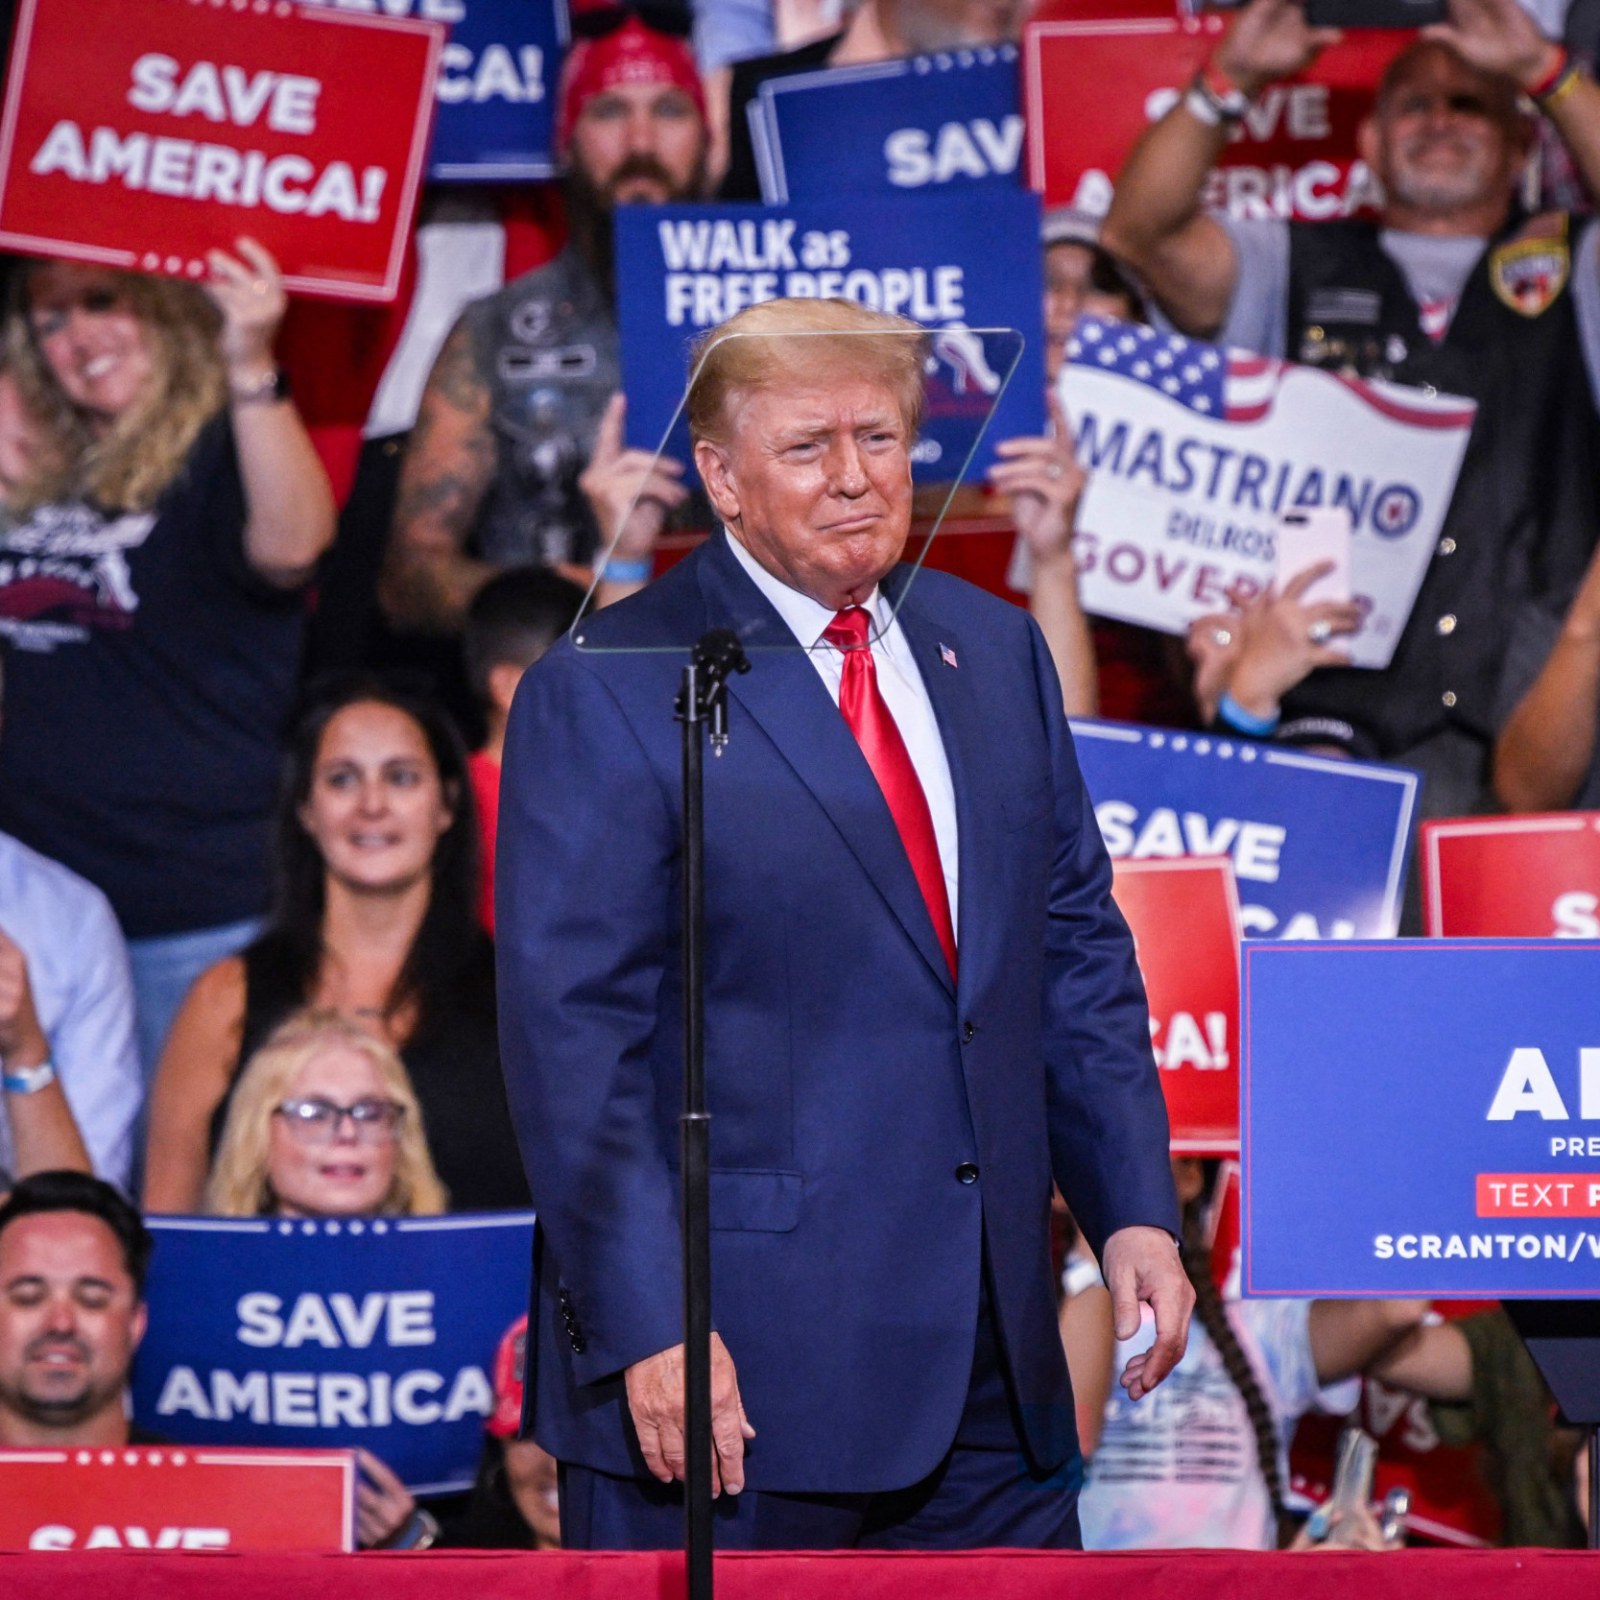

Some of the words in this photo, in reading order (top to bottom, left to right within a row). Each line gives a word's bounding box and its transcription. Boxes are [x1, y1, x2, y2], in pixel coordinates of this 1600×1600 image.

[128, 52, 322, 135] SAVE
[31, 119, 388, 223] AMERICA!
[657, 218, 797, 271] WALK
[801, 229, 852, 270] as
[1074, 411, 1424, 540] MASTRIANO
[1093, 799, 1288, 884] SAVE
[1488, 1183, 1575, 1207] TEXT
[236, 1290, 437, 1348] SAVE
[157, 1365, 495, 1429] AMERICA
